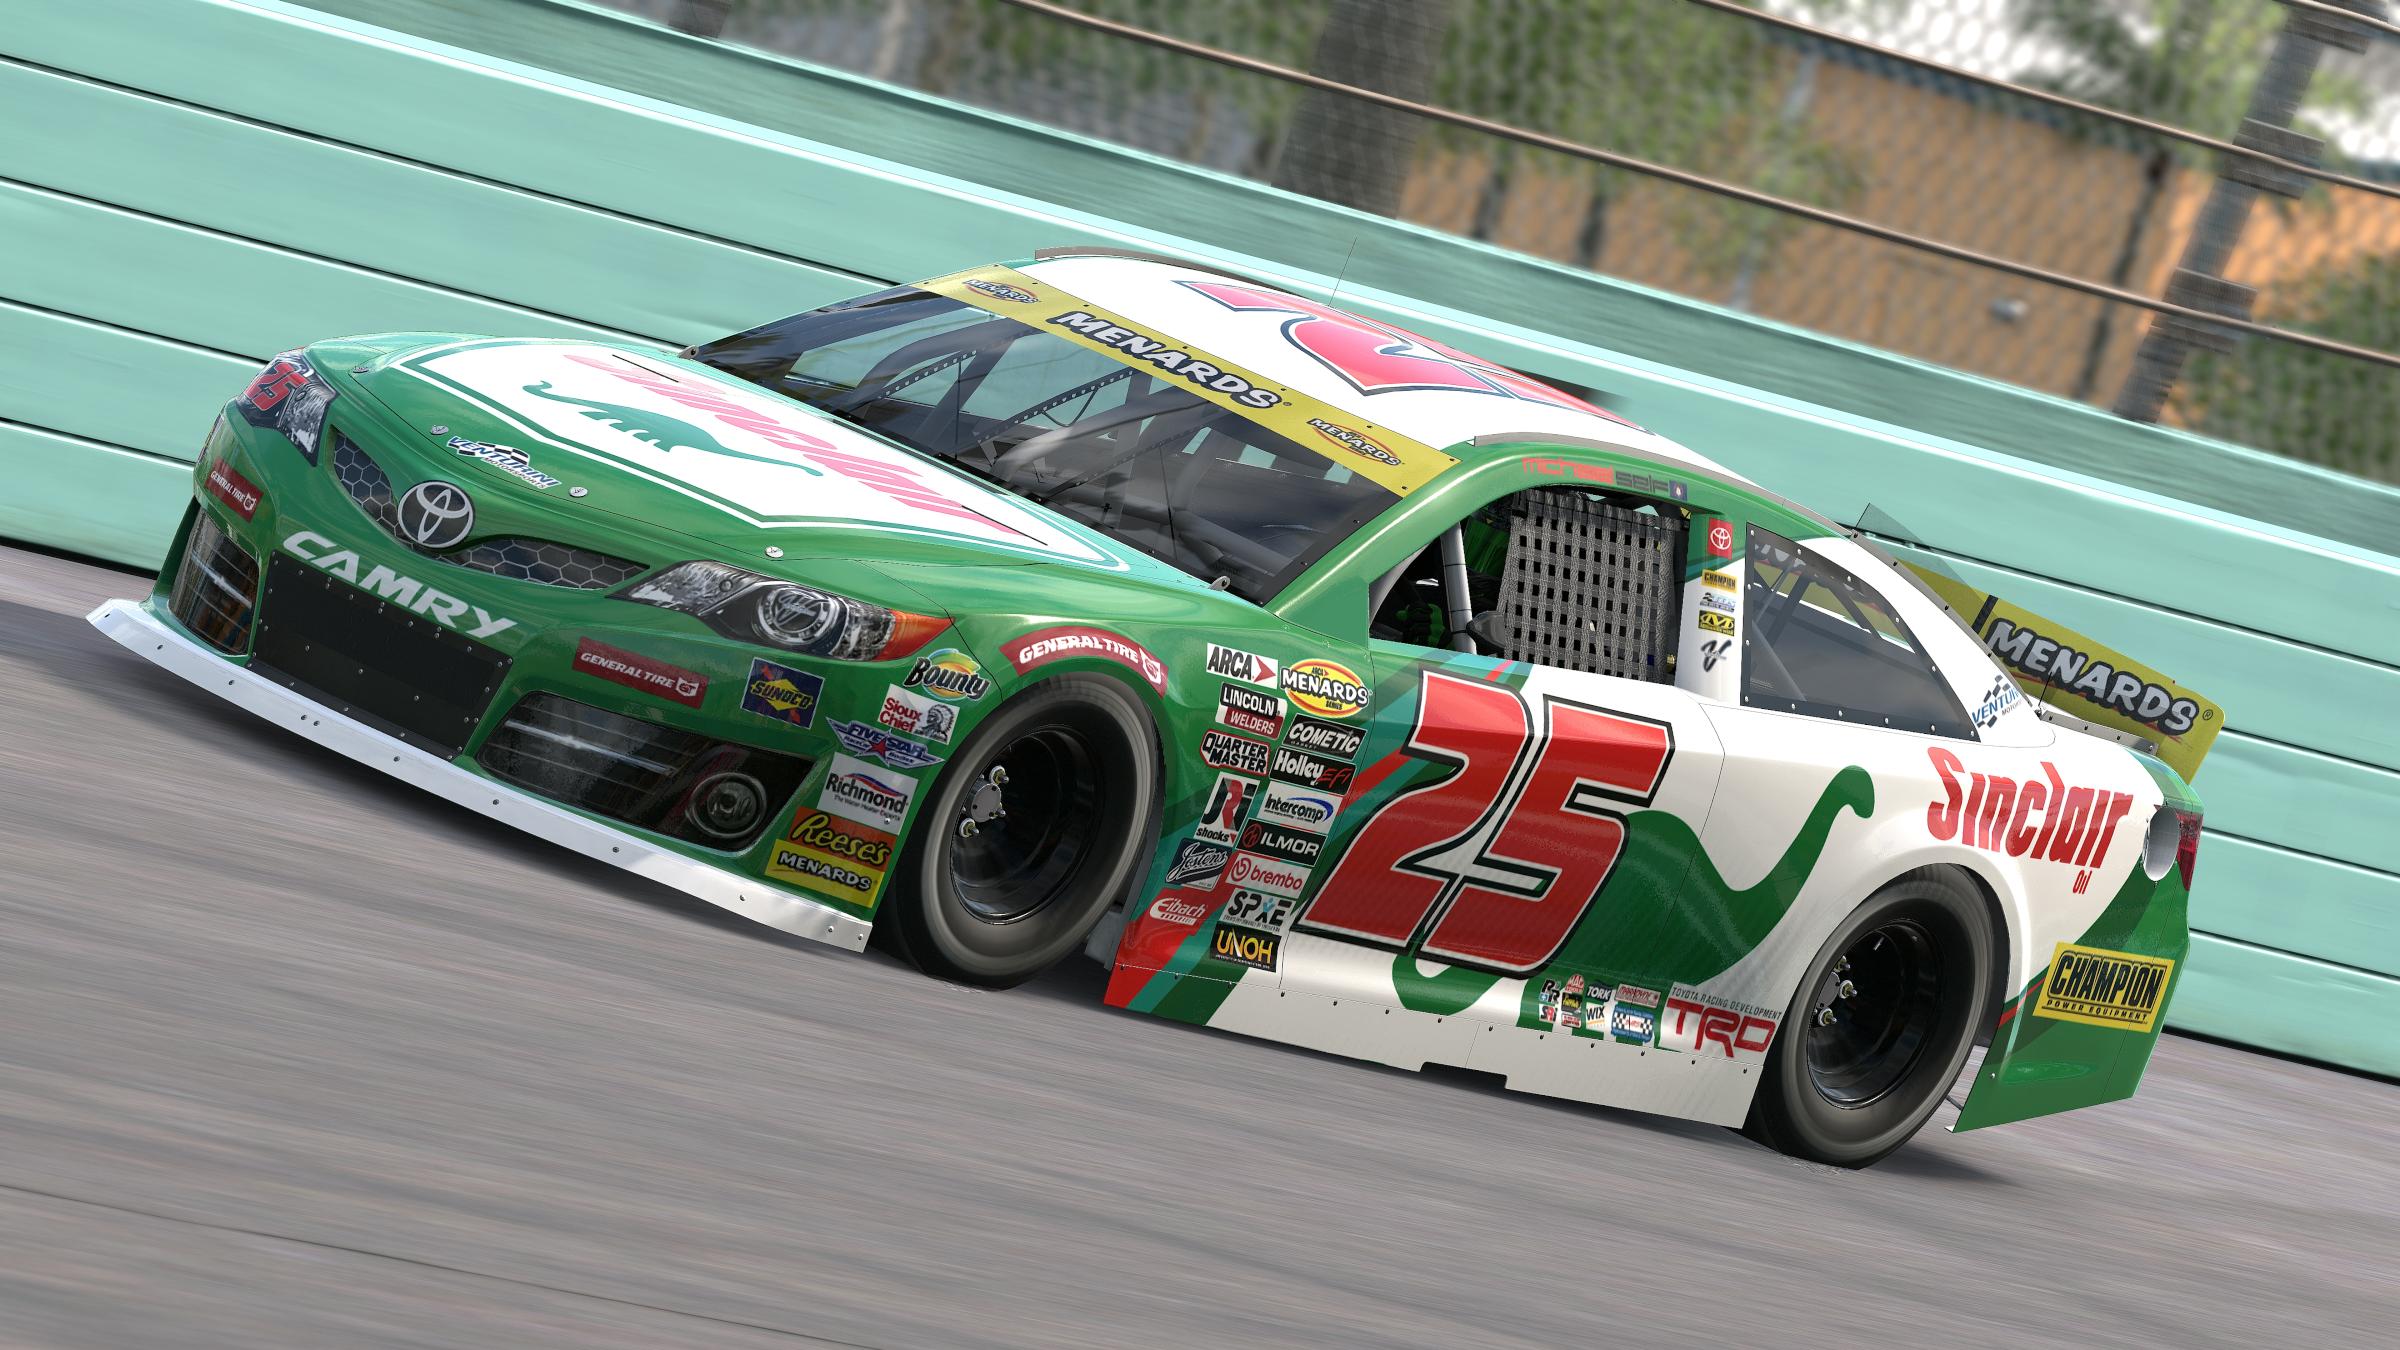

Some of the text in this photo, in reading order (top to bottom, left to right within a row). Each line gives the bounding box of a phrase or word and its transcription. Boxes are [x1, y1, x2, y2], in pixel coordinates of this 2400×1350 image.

[962, 280, 1039, 303] MENARDS
[1046, 310, 1282, 411] MENARDS
[1306, 418, 1401, 465] MENARDS
[449, 436, 559, 485] VENTURINI
[211, 470, 245, 502] GENERAL TIRE
[282, 531, 518, 638] CAMRY
[1019, 635, 1139, 664] GENERAL TIRE
[1207, 646, 1253, 680] ARCA
[581, 652, 642, 679] GENERAL
[643, 671, 676, 689] TIRE
[904, 657, 991, 701] Bounty
[1984, 619, 2199, 735] MENARDS
[752, 682, 812, 707] SUNOCO
[1222, 687, 1275, 717] LINCOLN
[1281, 668, 1369, 707] MENARDS
[880, 711, 917, 733] Chief
[884, 698, 922, 721] Sioux
[1230, 711, 1275, 735] WELDERS
[850, 723, 926, 757] FIVE STAR
[1202, 732, 1267, 758] QUARTER
[1289, 723, 1360, 753] COMETIC
[1209, 748, 1267, 772] MASTER
[1274, 750, 1325, 786] Holley
[826, 773, 907, 814] Richmond
[1265, 794, 1324, 824] Intercomp
[1927, 747, 2134, 869] Sinclair
[1196, 827, 1229, 842] shocks
[1290, 665, 1675, 980] 25
[790, 812, 892, 866] Reese's
[1260, 832, 1320, 856] ILMOR
[777, 850, 873, 891] MENARDS
[1250, 865, 1303, 890] brembo
[2072, 869, 2093, 894] Oil
[1150, 898, 1206, 922] Eibach
[1217, 928, 1273, 964] UNOH
[1587, 985, 1611, 1000] TORK
[2050, 954, 2167, 1009] CHAMPION
[1587, 1006, 1605, 1020] WIX
[1672, 987, 1698, 1001] TOYOTA
[1700, 993, 1729, 1008] RACING
[1730, 1001, 1782, 1020] DEVELOPMENT
[2047, 1000, 2148, 1021] POWER EQUIPMENT
[1667, 998, 1776, 1058] TRD
